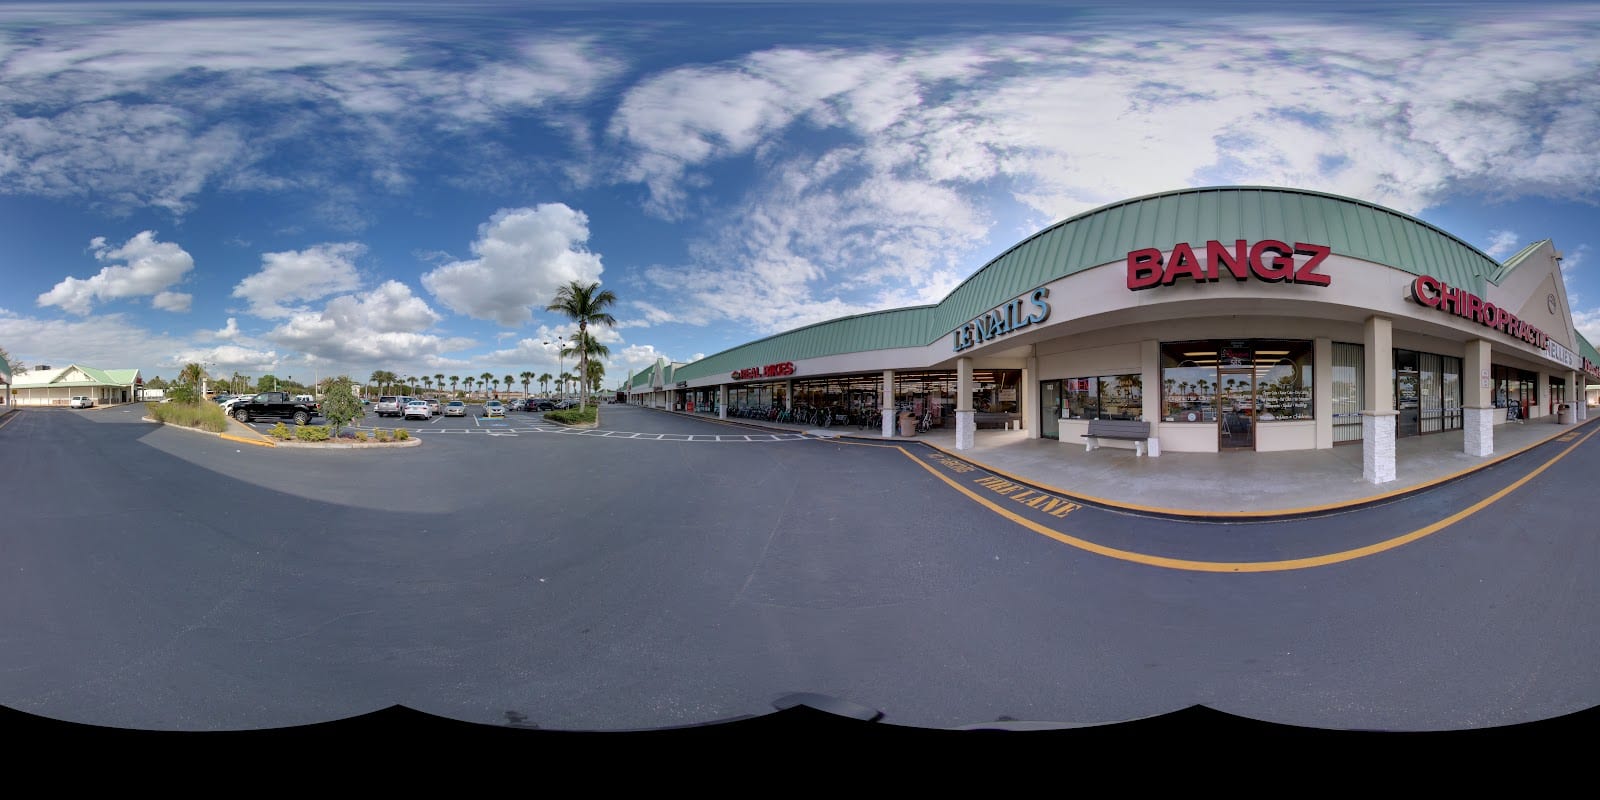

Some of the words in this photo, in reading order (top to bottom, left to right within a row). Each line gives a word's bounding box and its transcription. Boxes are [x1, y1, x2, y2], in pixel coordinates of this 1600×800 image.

[1127, 239, 1331, 291] BANGZ
[953, 323, 974, 352] LE
[974, 287, 1051, 344] NAILS
[1411, 275, 1549, 351] CHIROPRACTIC
[740, 367, 761, 379] REAL
[763, 361, 794, 377] BIKES
[973, 476, 1020, 495] FIRE
[1009, 490, 1083, 519] LANE
